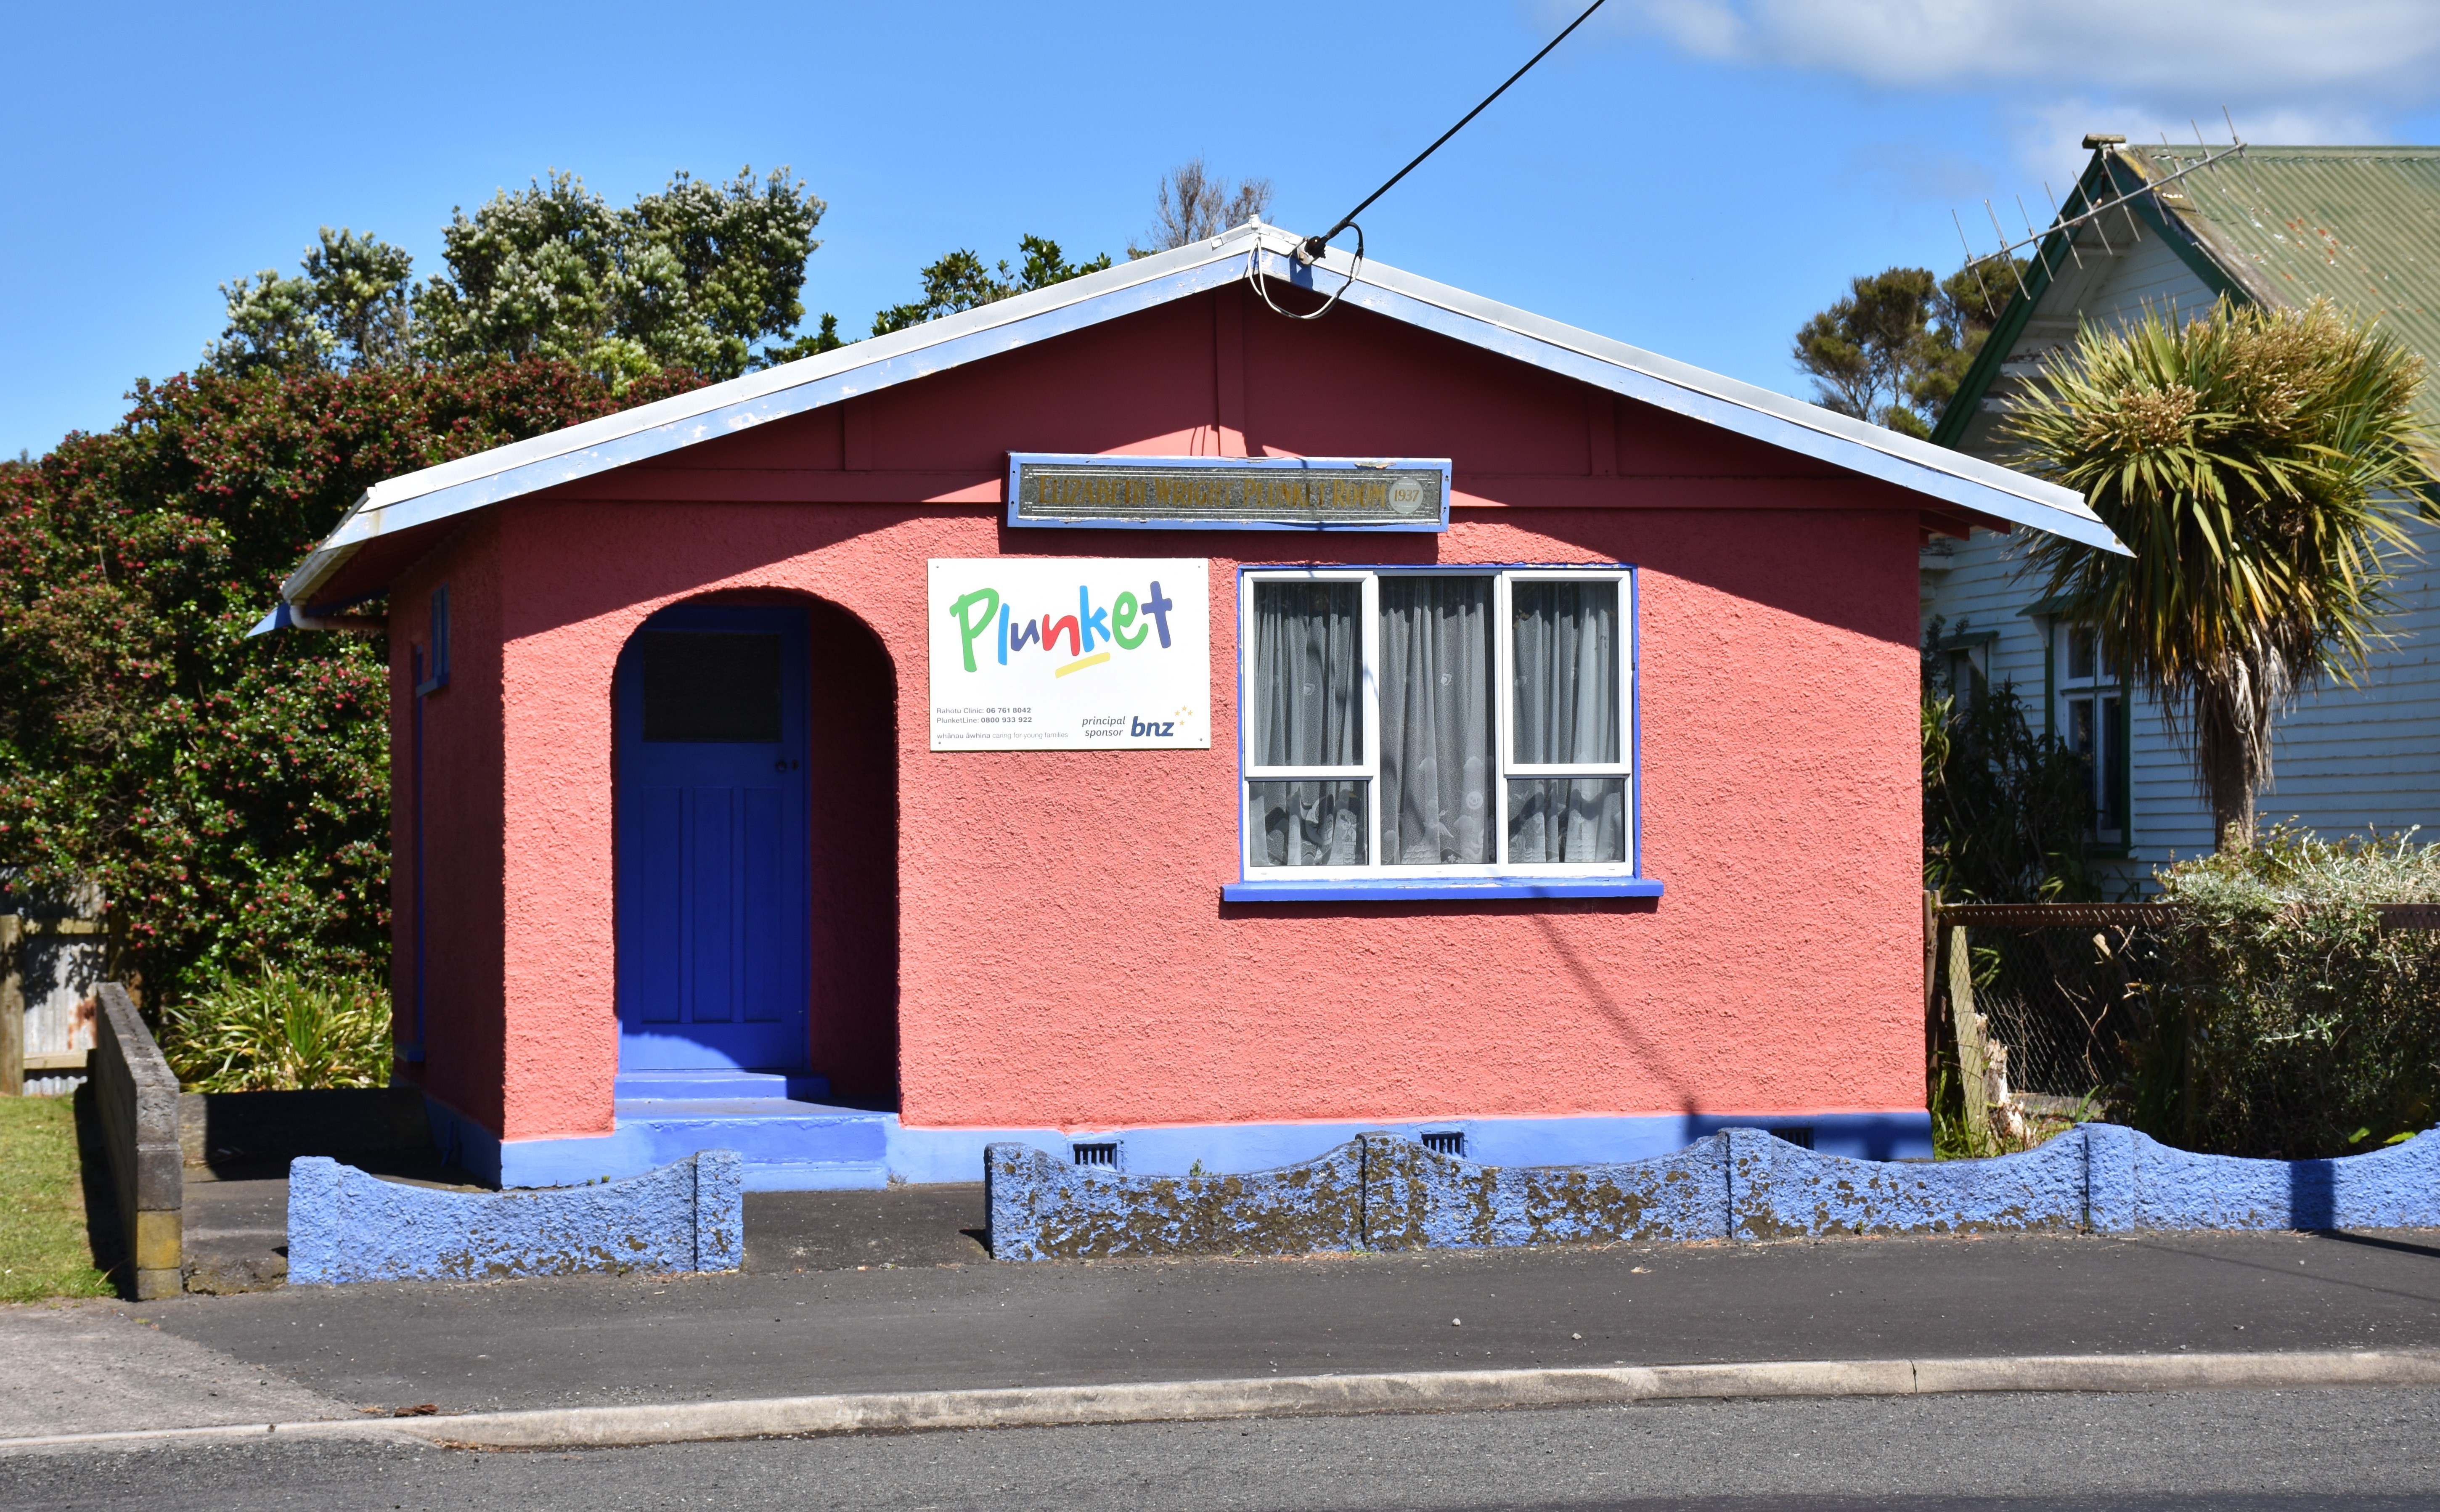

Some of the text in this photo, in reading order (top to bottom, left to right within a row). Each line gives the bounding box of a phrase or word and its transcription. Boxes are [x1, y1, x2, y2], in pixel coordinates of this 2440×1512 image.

[1039, 475, 1420, 508] ELIZABETH WRIGHT PLUNKET ROOM 1937
[949, 581, 1173, 673] Plunket
[1082, 715, 1126, 727] principal
[1130, 715, 1175, 737] bnz
[1085, 730, 1123, 739] sponsor
